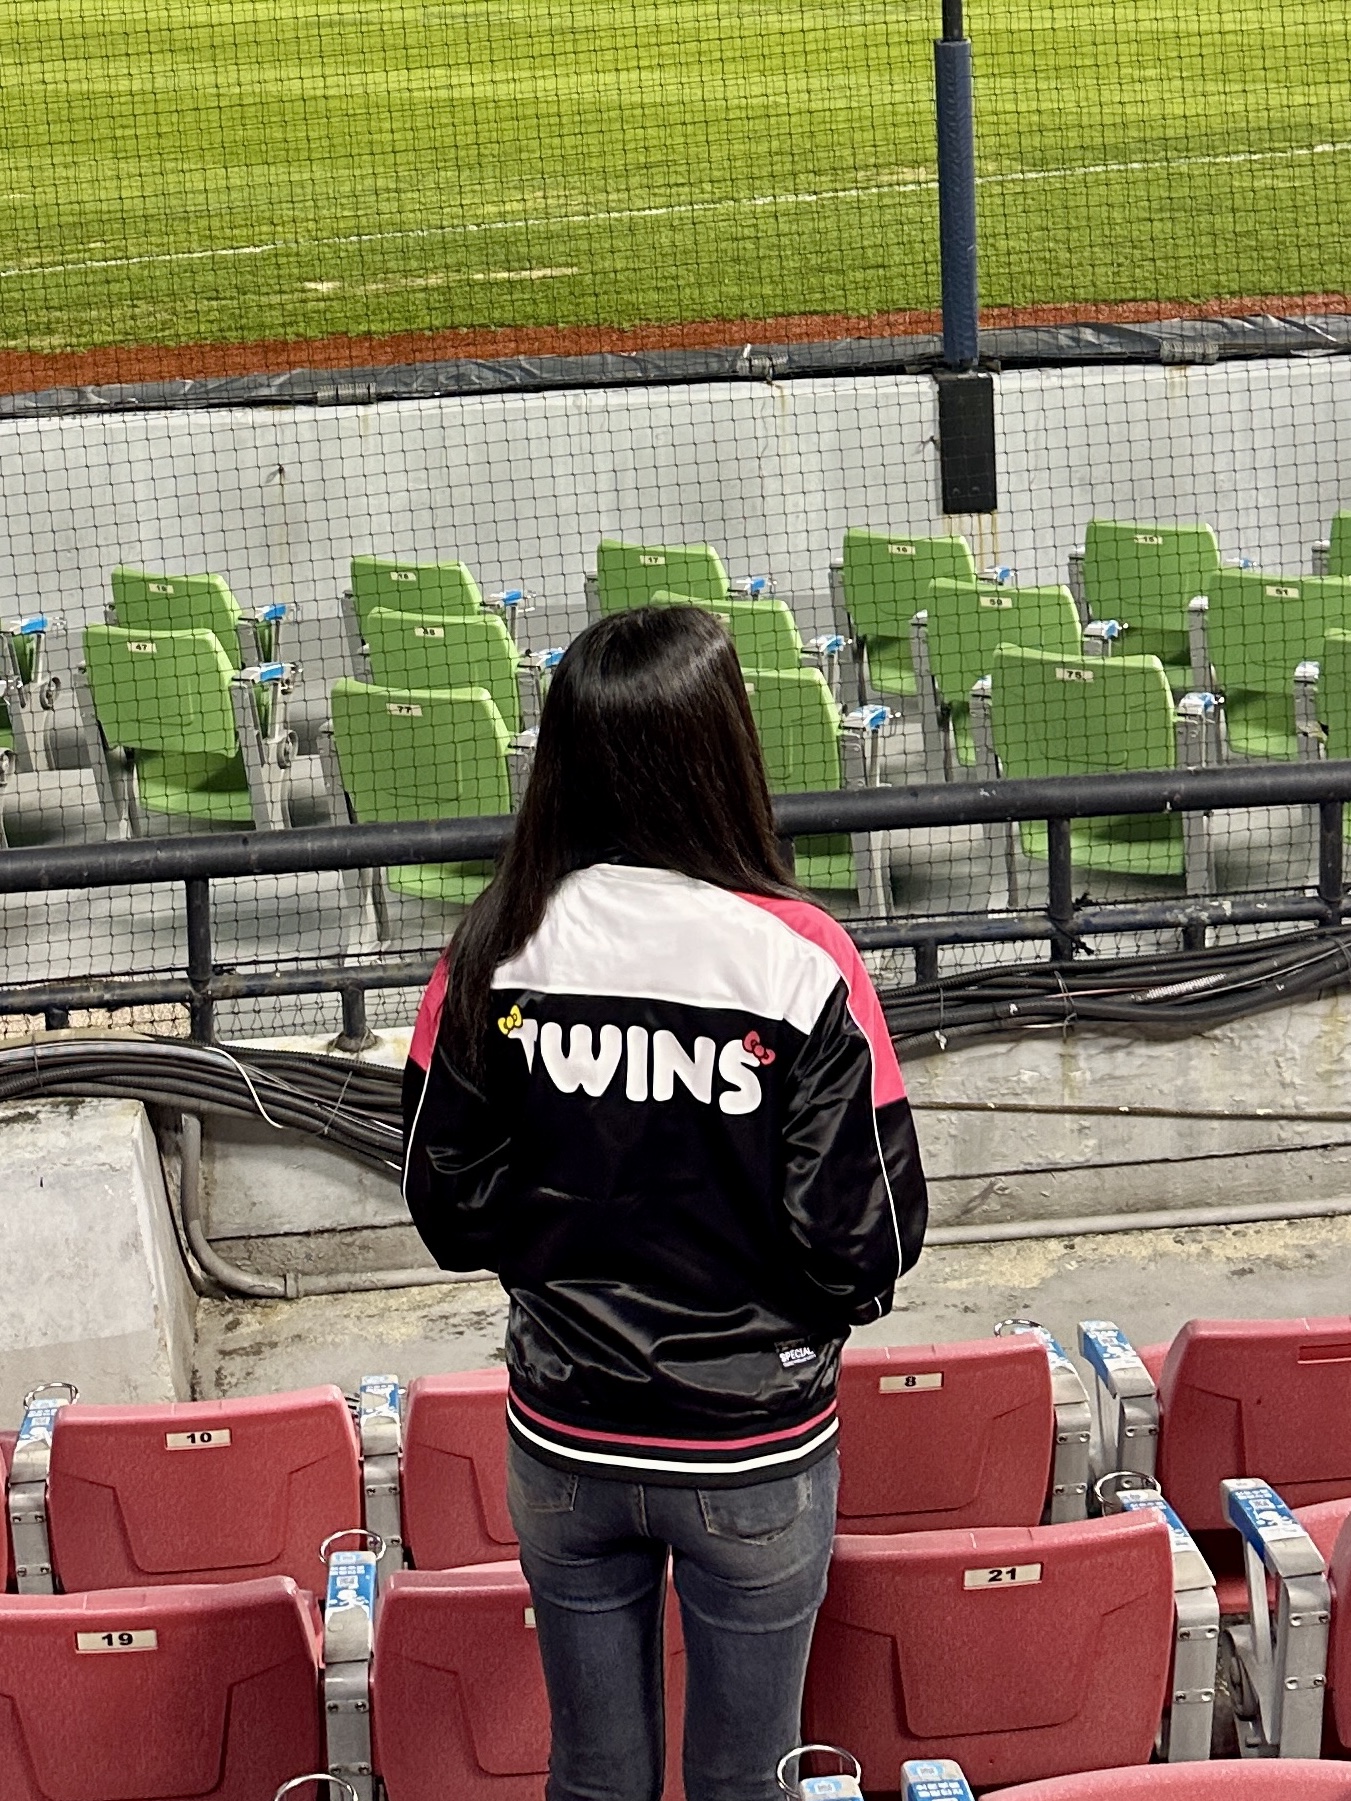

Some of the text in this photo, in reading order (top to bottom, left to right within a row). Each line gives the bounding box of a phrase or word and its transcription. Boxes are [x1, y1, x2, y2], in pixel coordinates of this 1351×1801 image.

[507, 1018, 763, 1115] TWINS
[779, 1347, 815, 1363] SPECIAL
[904, 1375, 917, 1387] 8
[186, 1432, 213, 1444] 10
[987, 1568, 1017, 1582] 21
[101, 1632, 134, 1647] 19
